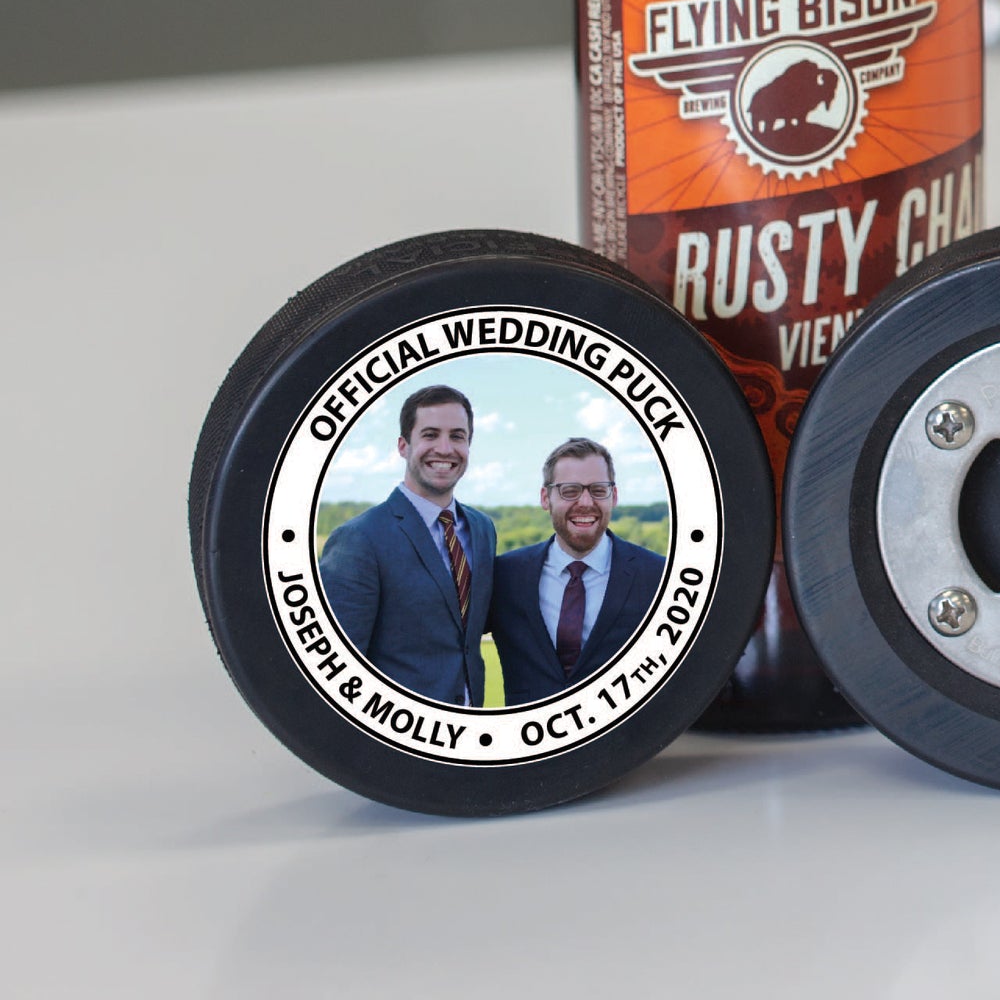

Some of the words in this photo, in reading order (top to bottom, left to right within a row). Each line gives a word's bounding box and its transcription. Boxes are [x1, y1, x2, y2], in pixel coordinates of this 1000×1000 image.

[588, 20, 602, 62] CASH
[611, 30, 622, 57] USA
[589, 63, 602, 85] CA
[612, 59, 624, 83] THE
[860, 61, 901, 85] COMPANY
[613, 86, 624, 104] OF
[683, 95, 727, 114] BREWING
[673, 199, 878, 320] RUSTY
[896, 153, 983, 278] CHAI
[778, 308, 864, 371] VIEN
[309, 332, 441, 442] OFFICIAL
[442, 318, 610, 371] WEDDING
[607, 359, 685, 442] PUCK
[277, 571, 348, 681] JOSEPH
[338, 675, 363, 705] &
[361, 692, 467, 750] MOLLY
[520, 704, 596, 746] OCT.
[656, 567, 704, 646] 2020
